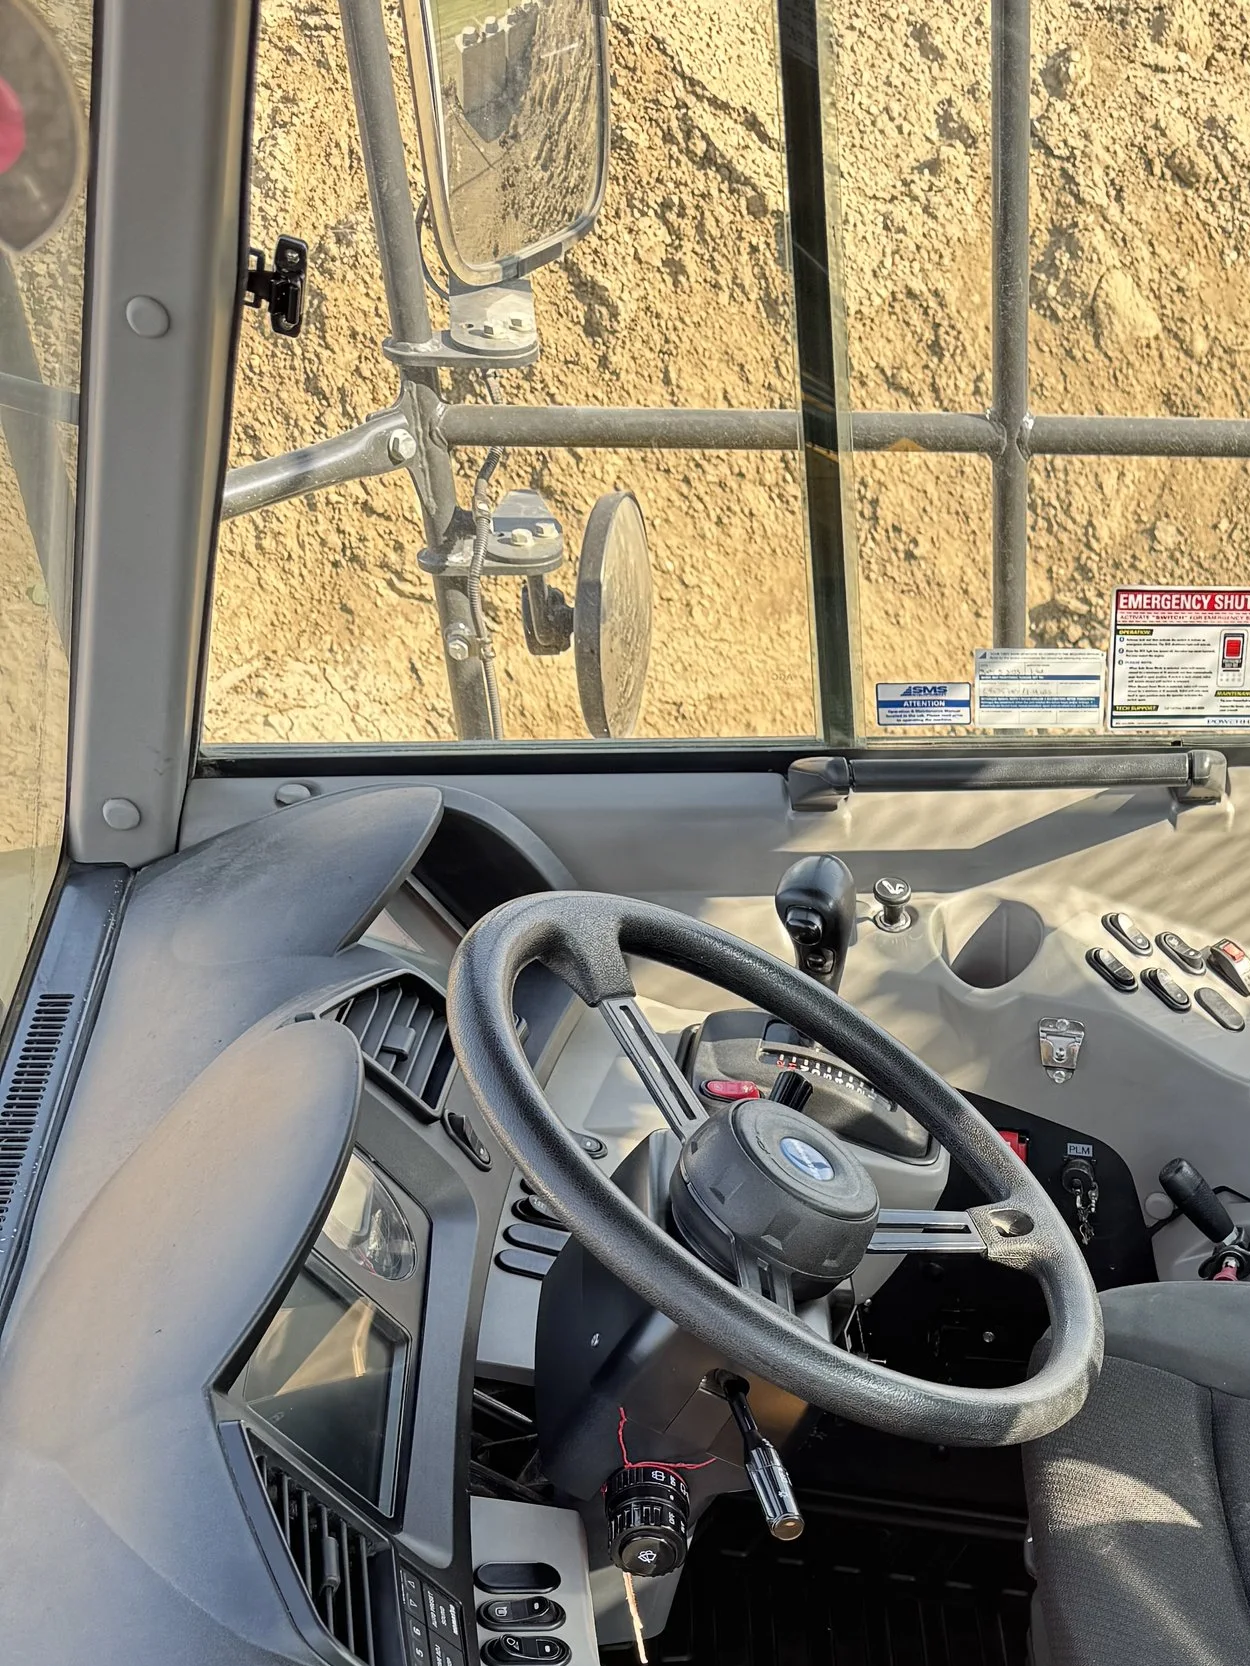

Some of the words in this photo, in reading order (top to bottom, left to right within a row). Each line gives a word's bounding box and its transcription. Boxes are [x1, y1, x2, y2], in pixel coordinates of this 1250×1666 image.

[1119, 593, 1211, 610] EMERGENCY
[912, 686, 947, 694] SMS
[823, 1072, 832, 1081] 5
[846, 1082, 855, 1090] 3
[1069, 1145, 1091, 1155] PLM
[413, 1626, 421, 1637] 6
[416, 1648, 423, 1657] 5
